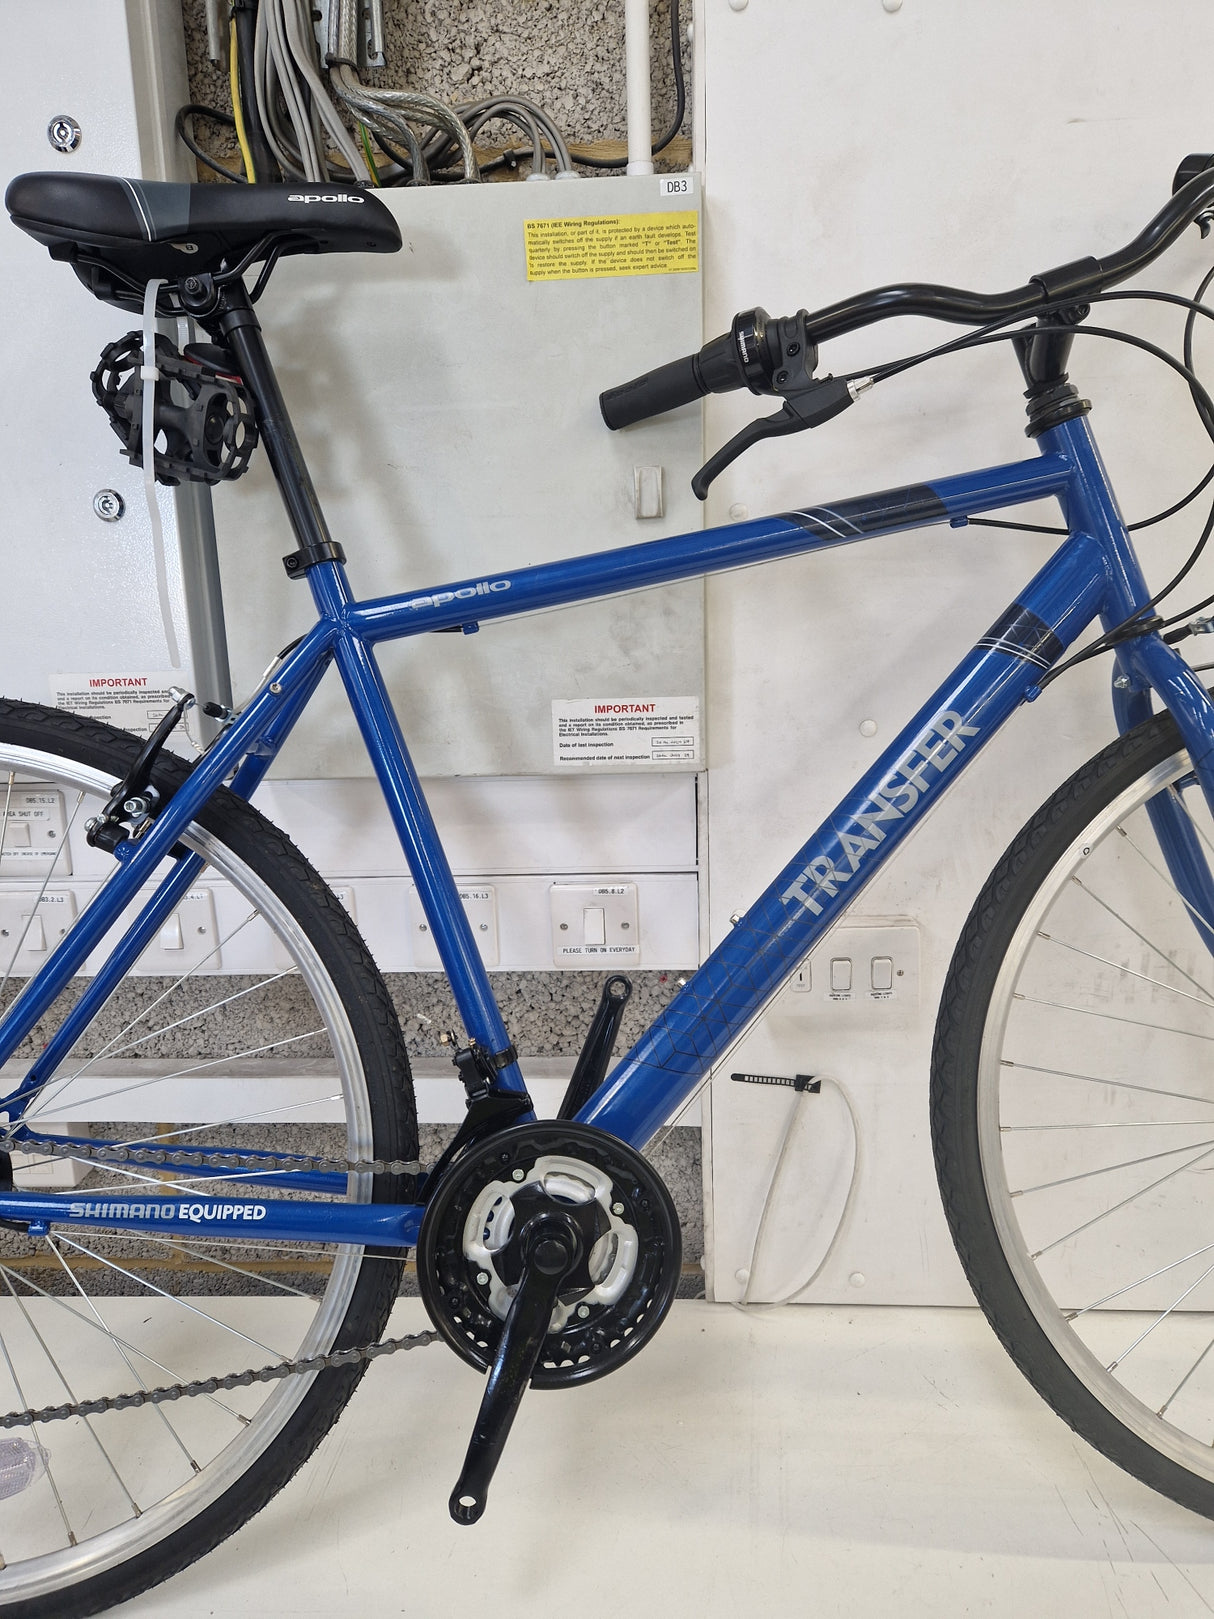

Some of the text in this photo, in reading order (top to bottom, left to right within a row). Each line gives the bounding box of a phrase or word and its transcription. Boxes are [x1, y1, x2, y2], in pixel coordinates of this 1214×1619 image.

[667, 180, 688, 192] DB3
[288, 194, 364, 203] apollo
[410, 580, 512, 608] apollo
[90, 678, 148, 687] IMPORTANT
[594, 704, 656, 713] IMPORTANT
[779, 710, 981, 916] TRANSFER
[69, 1202, 266, 1222] SHIMANO EQUIPPED
